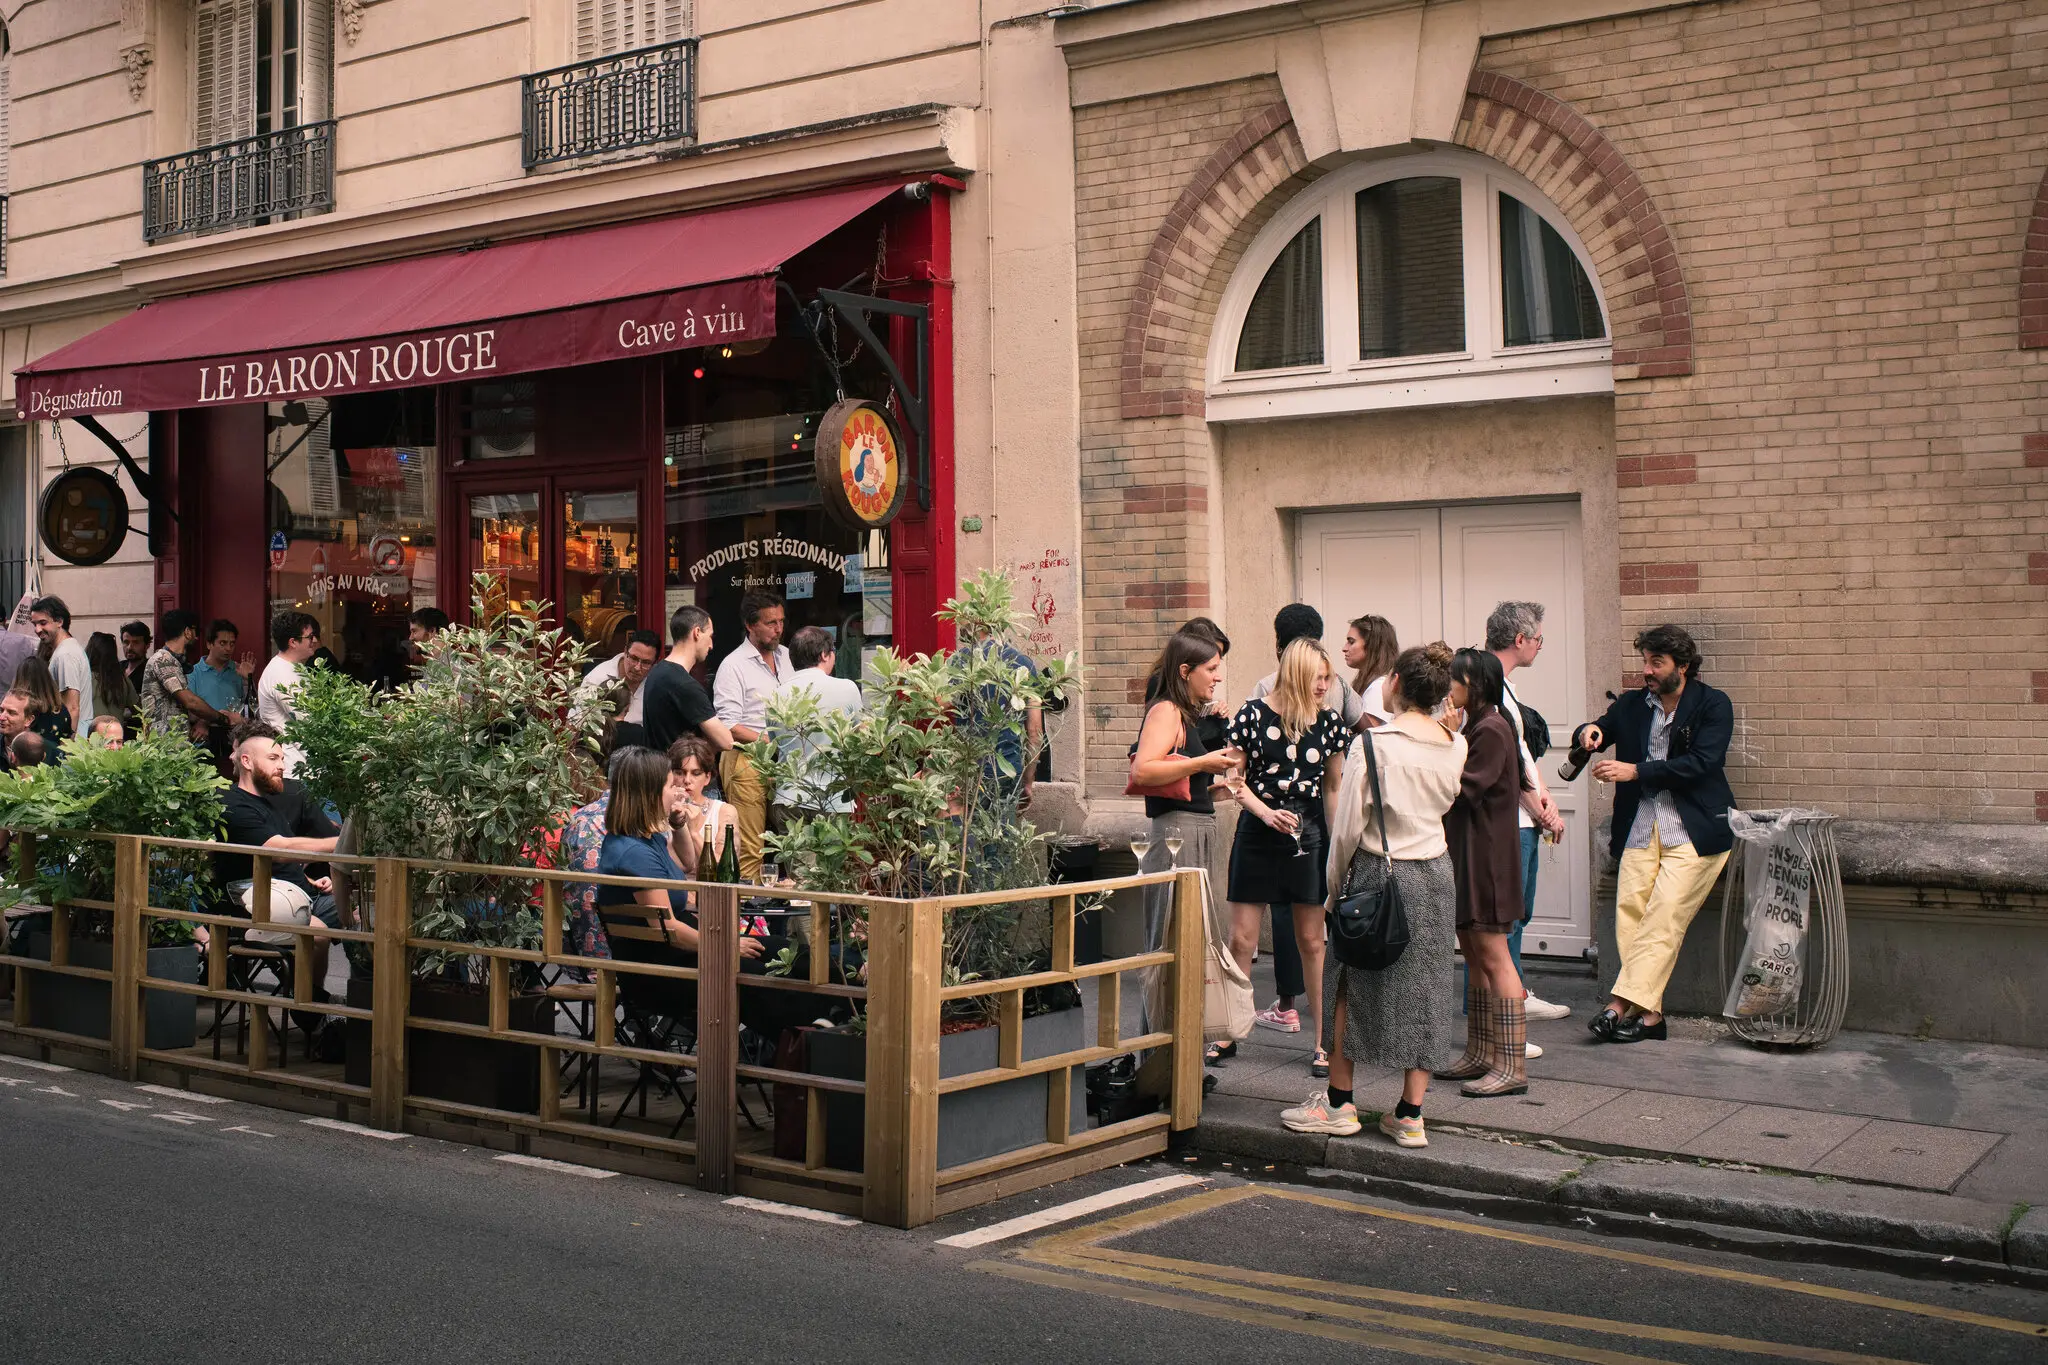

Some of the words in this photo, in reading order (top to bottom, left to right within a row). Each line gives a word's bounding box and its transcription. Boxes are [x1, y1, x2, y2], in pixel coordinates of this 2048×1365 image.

[618, 319, 676, 348] Cave
[683, 308, 696, 339] à
[703, 303, 746, 335] vin
[197, 364, 236, 402] LE
[244, 348, 362, 398] BARON
[369, 329, 497, 384] ROUGE
[30, 383, 122, 418] Dégustation
[842, 414, 894, 465] BARON
[862, 435, 874, 449] LE
[842, 469, 891, 514] ROUGE
[689, 540, 759, 582] PRODUITS
[763, 531, 851, 576] RÉGIONAUX
[337, 573, 353, 590] AU
[356, 575, 389, 598] VRAC
[730, 576, 743, 587] Sur
[744, 574, 765, 591] place
[766, 573, 775, 586] et
[776, 574, 782, 585] à
[1761, 960, 1791, 976] PARIS
